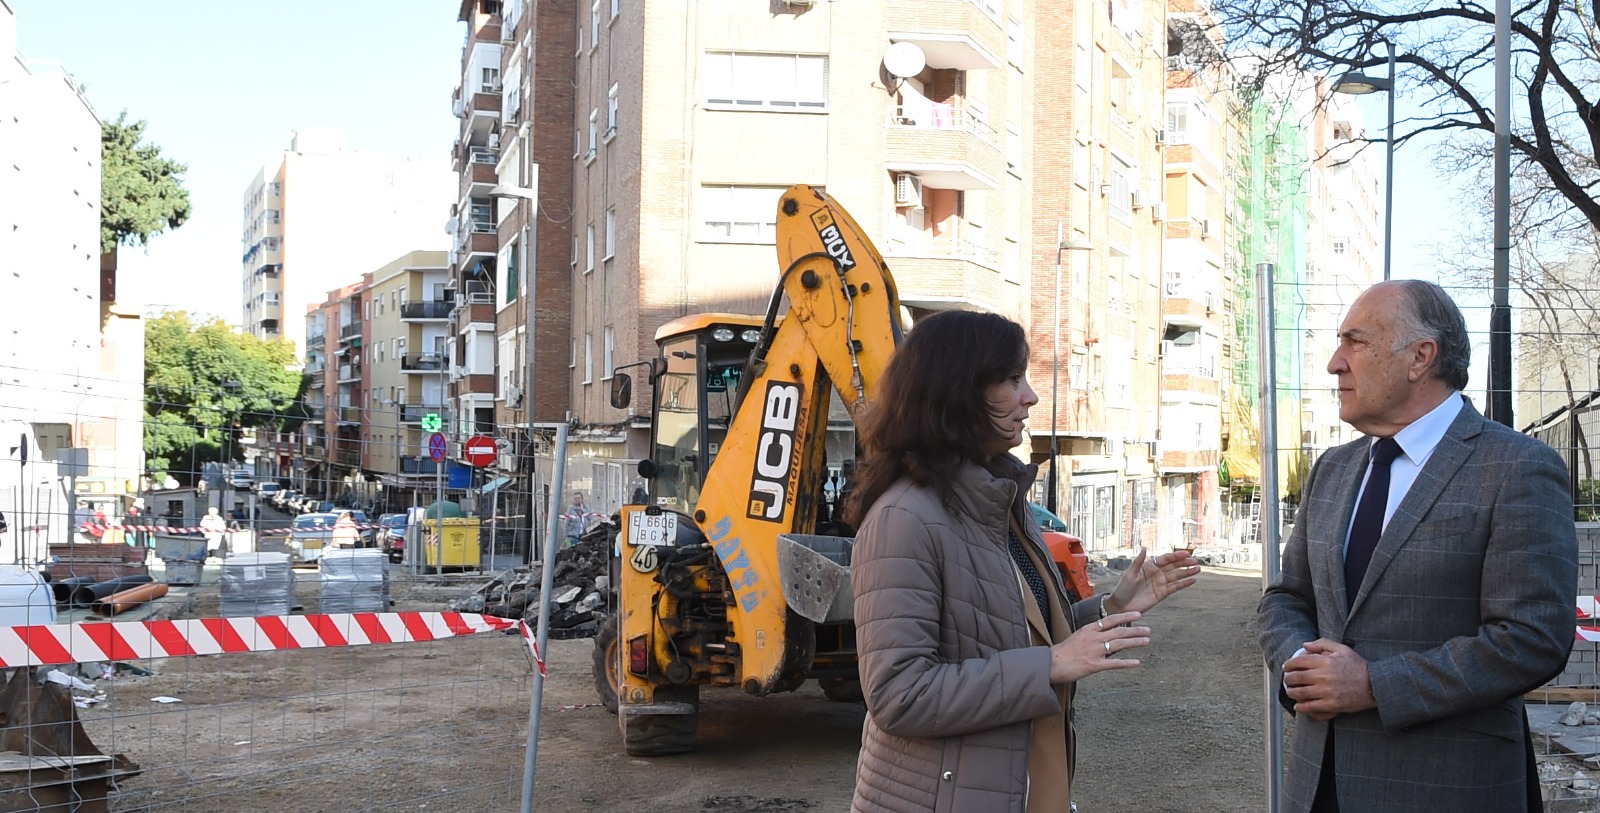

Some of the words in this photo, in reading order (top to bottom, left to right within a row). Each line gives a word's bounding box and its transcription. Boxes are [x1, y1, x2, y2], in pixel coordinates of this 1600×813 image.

[751, 385, 800, 519] JCB
[786, 407, 808, 505] MAQUIJESA
[633, 545, 655, 569] 40
